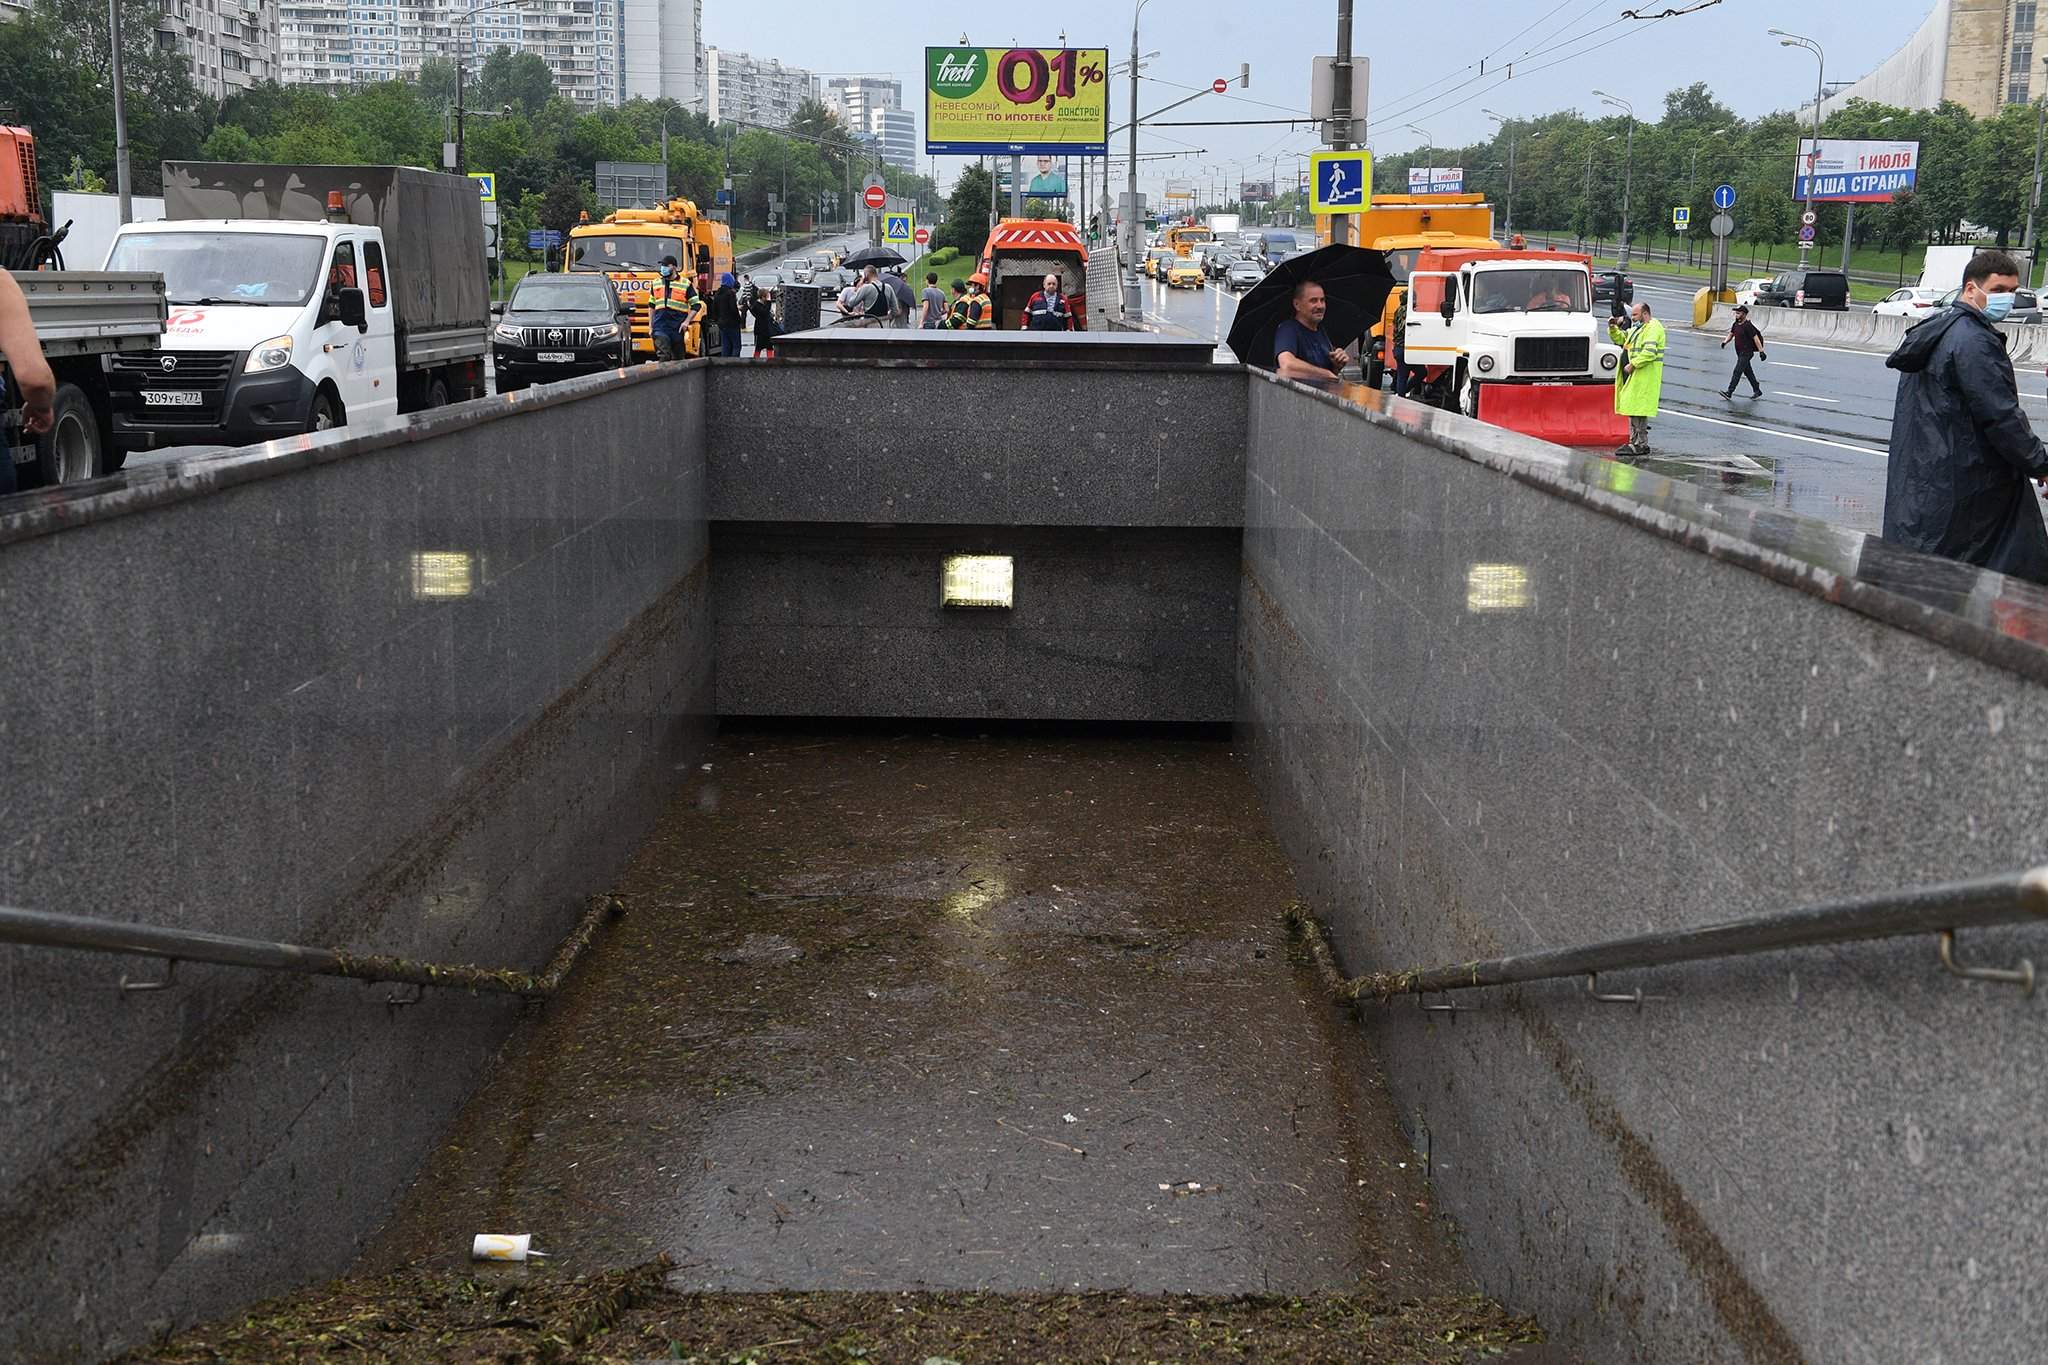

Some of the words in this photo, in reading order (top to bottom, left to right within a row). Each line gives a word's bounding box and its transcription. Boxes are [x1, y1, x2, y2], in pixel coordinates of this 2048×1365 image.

[936, 53, 979, 82] fresh
[934, 101, 1000, 111] НЕВЕСОМЫЙ
[1058, 105, 1100, 117] ДОНСТРОЙ
[934, 112, 983, 121] ПРОЦЕНТ
[986, 113, 1002, 121] ПО
[1005, 113, 1054, 122] ИПОТЕКЕ
[1859, 155, 1865, 170] 1
[1868, 152, 1911, 169] ИЮЛЯ
[1433, 182, 1460, 192] СТРАНА
[1850, 173, 1907, 192] СТРАНА
